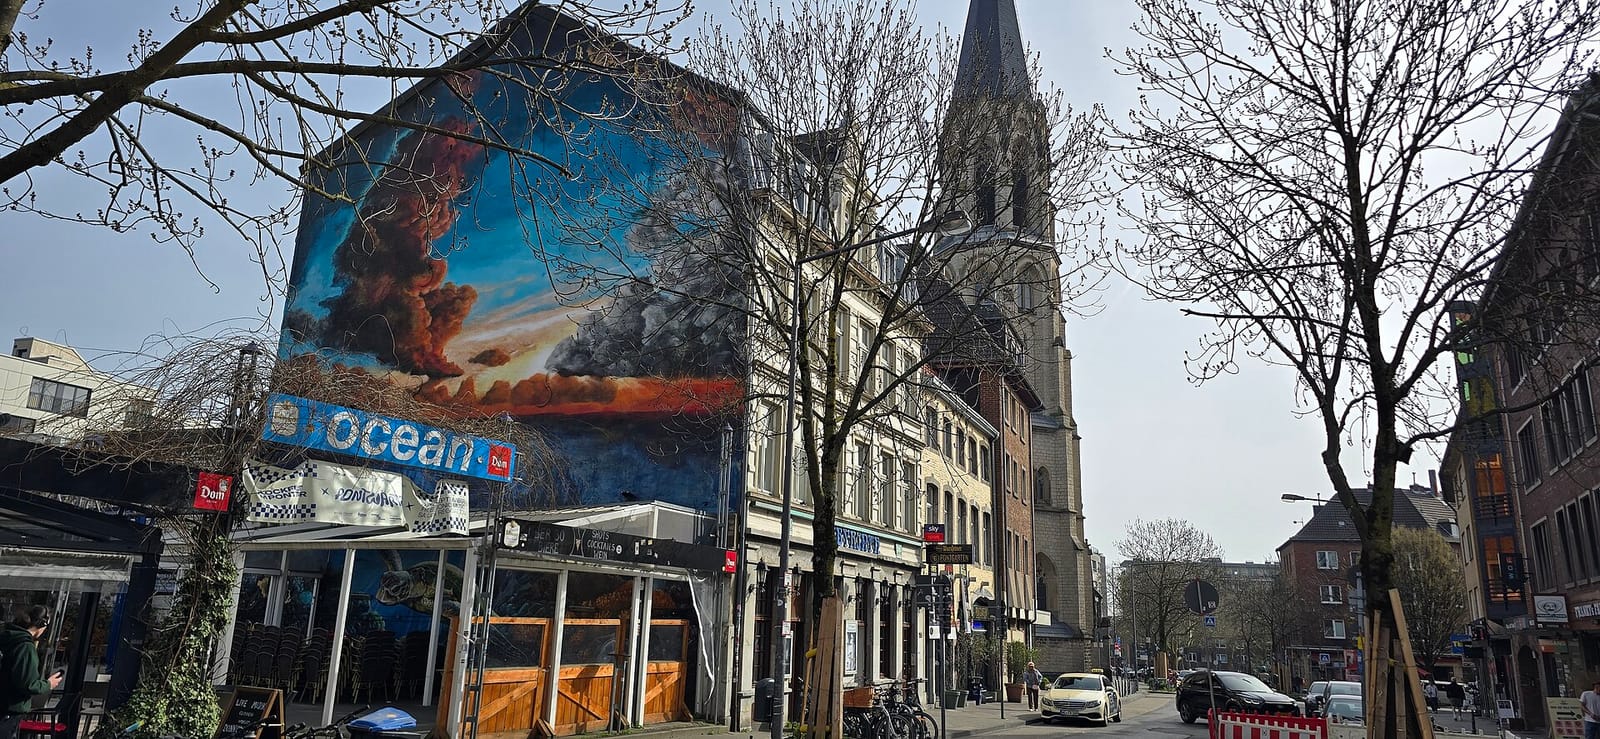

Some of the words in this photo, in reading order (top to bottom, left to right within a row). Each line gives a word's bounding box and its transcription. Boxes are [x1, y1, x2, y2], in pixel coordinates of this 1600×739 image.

[327, 410, 475, 472] ocean
[200, 485, 225, 500] Dom
[928, 525, 940, 533] sky
[592, 530, 610, 540] SHOTS
[587, 540, 616, 551] COCKTAILS
